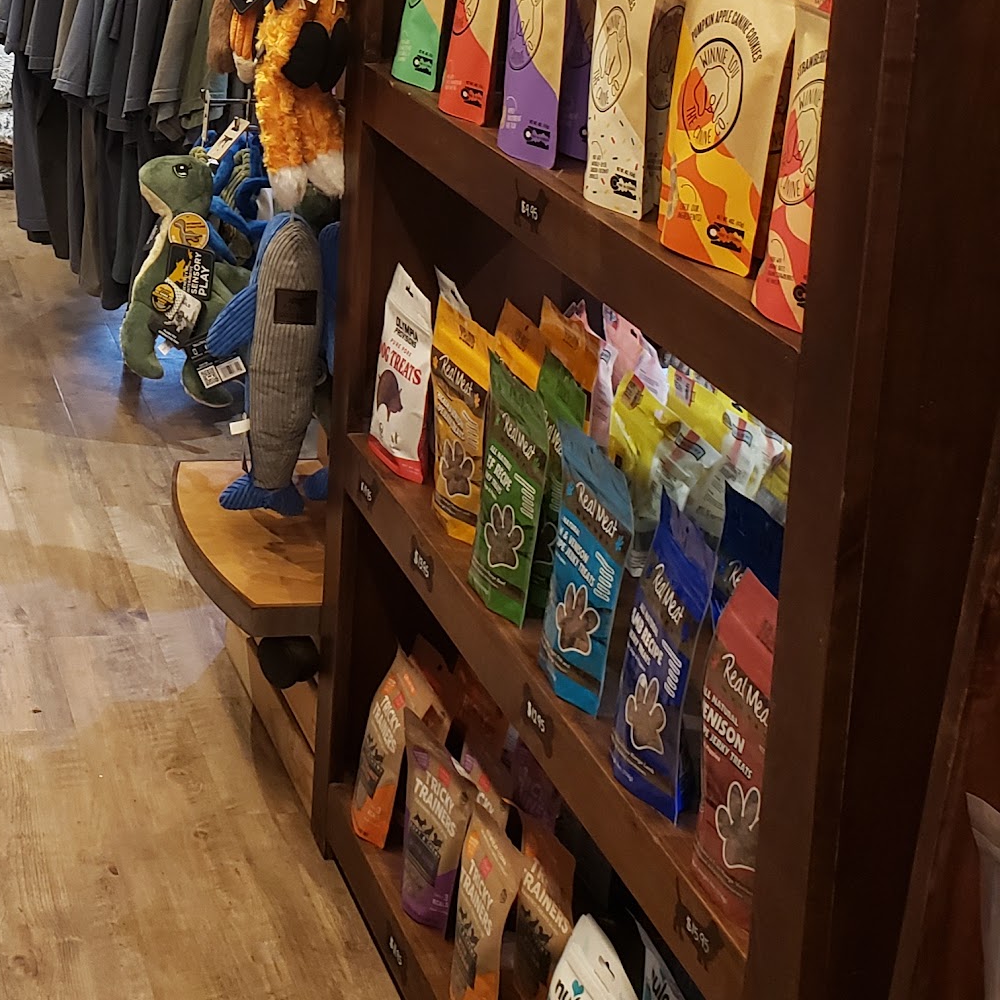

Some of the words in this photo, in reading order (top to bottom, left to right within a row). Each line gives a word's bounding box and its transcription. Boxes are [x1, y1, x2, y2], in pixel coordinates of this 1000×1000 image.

[691, 11, 714, 40] PUMPKIN
[714, 9, 732, 25] APPLE
[731, 11, 752, 34] CANINE
[746, 27, 763, 64] COOKIES
[699, 47, 728, 69] WINNIE
[728, 57, 741, 80] LOU
[687, 106, 699, 126] THE
[714, 120, 729, 138] CO.
[191, 251, 203, 295] SENSORY
[198, 265, 211, 297] PLAY
[390, 338, 401, 349] PURE
[402, 346, 412, 357] PORK
[395, 316, 419, 342] OLYMPIA
[379, 342, 390, 362] OG
[389, 350, 422, 386] TREATS
[439, 354, 456, 382] Real
[454, 370, 475, 398] Meat
[501, 412, 518, 443] Real
[516, 433, 536, 461] Meat
[494, 462, 513, 492] RECIPE
[576, 481, 597, 519] Real
[595, 502, 618, 539] Meat
[568, 535, 590, 565] VENISON
[655, 563, 669, 607] Real
[664, 588, 685, 626] Meat
[640, 624, 664, 666] RECIPE
[711, 695, 739, 727] NATURAL
[722, 653, 746, 699] Real
[747, 684, 771, 728] Mea
[372, 701, 397, 754] TRAINERS
[380, 694, 401, 734] TRICKY
[702, 706, 746, 754] ENISON
[709, 730, 730, 757] JERKY
[729, 752, 753, 781] TREATS
[413, 777, 456, 838] TRAINERS
[425, 770, 455, 814] TRICKY
[460, 866, 493, 937] TRAINERS
[468, 858, 494, 911] TRICKY
[523, 869, 569, 934] RAINERS
